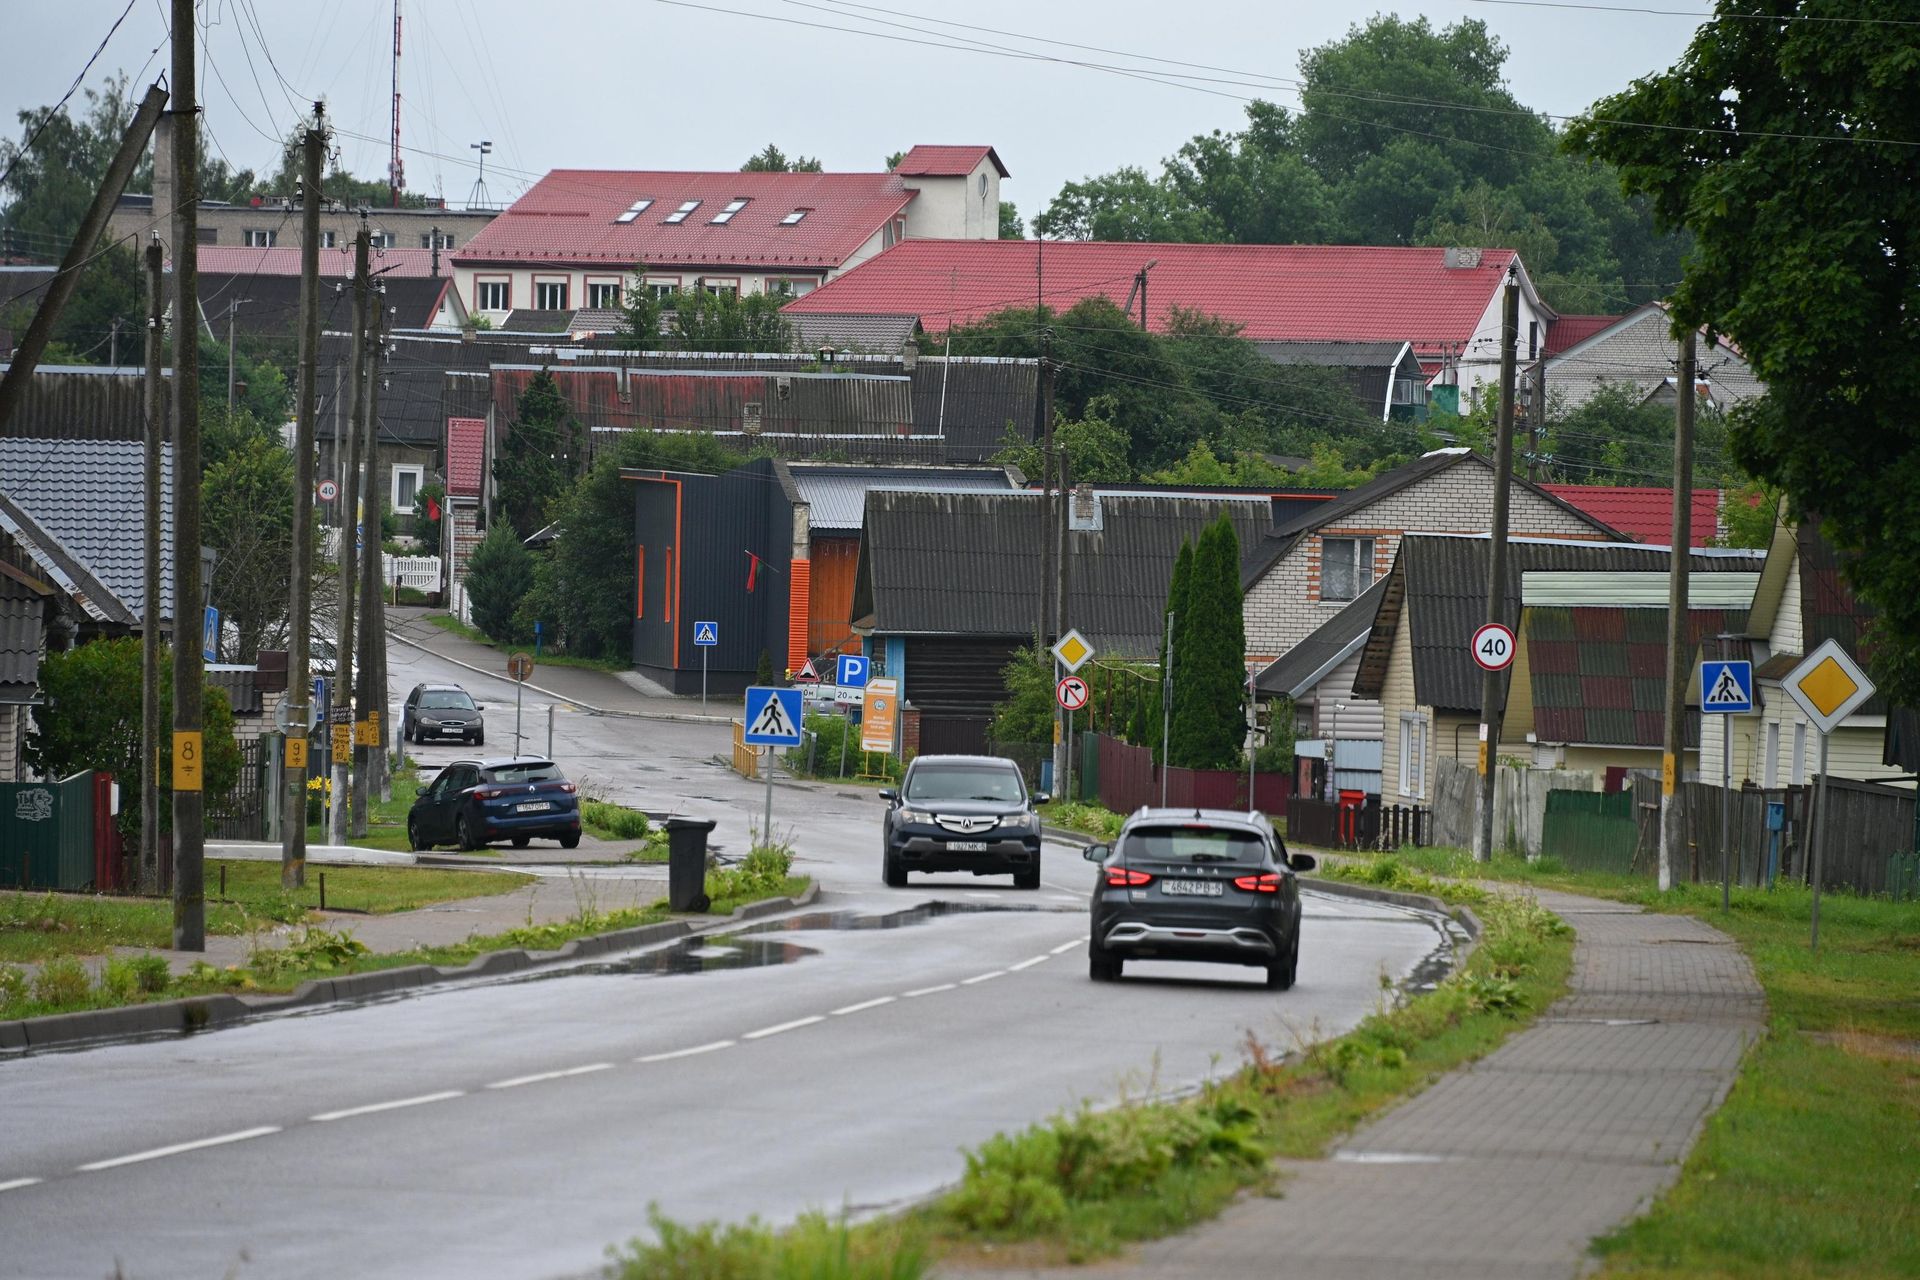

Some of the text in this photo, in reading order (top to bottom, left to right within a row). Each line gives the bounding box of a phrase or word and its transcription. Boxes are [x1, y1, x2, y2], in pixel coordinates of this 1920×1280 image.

[321, 486, 334, 496] 40
[1481, 638, 1506, 656] 40
[844, 658, 862, 684] P
[837, 691, 848, 699] 20
[182, 741, 194, 760] 8
[293, 742, 300, 756] 9
[1166, 866, 1218, 875] LADA
